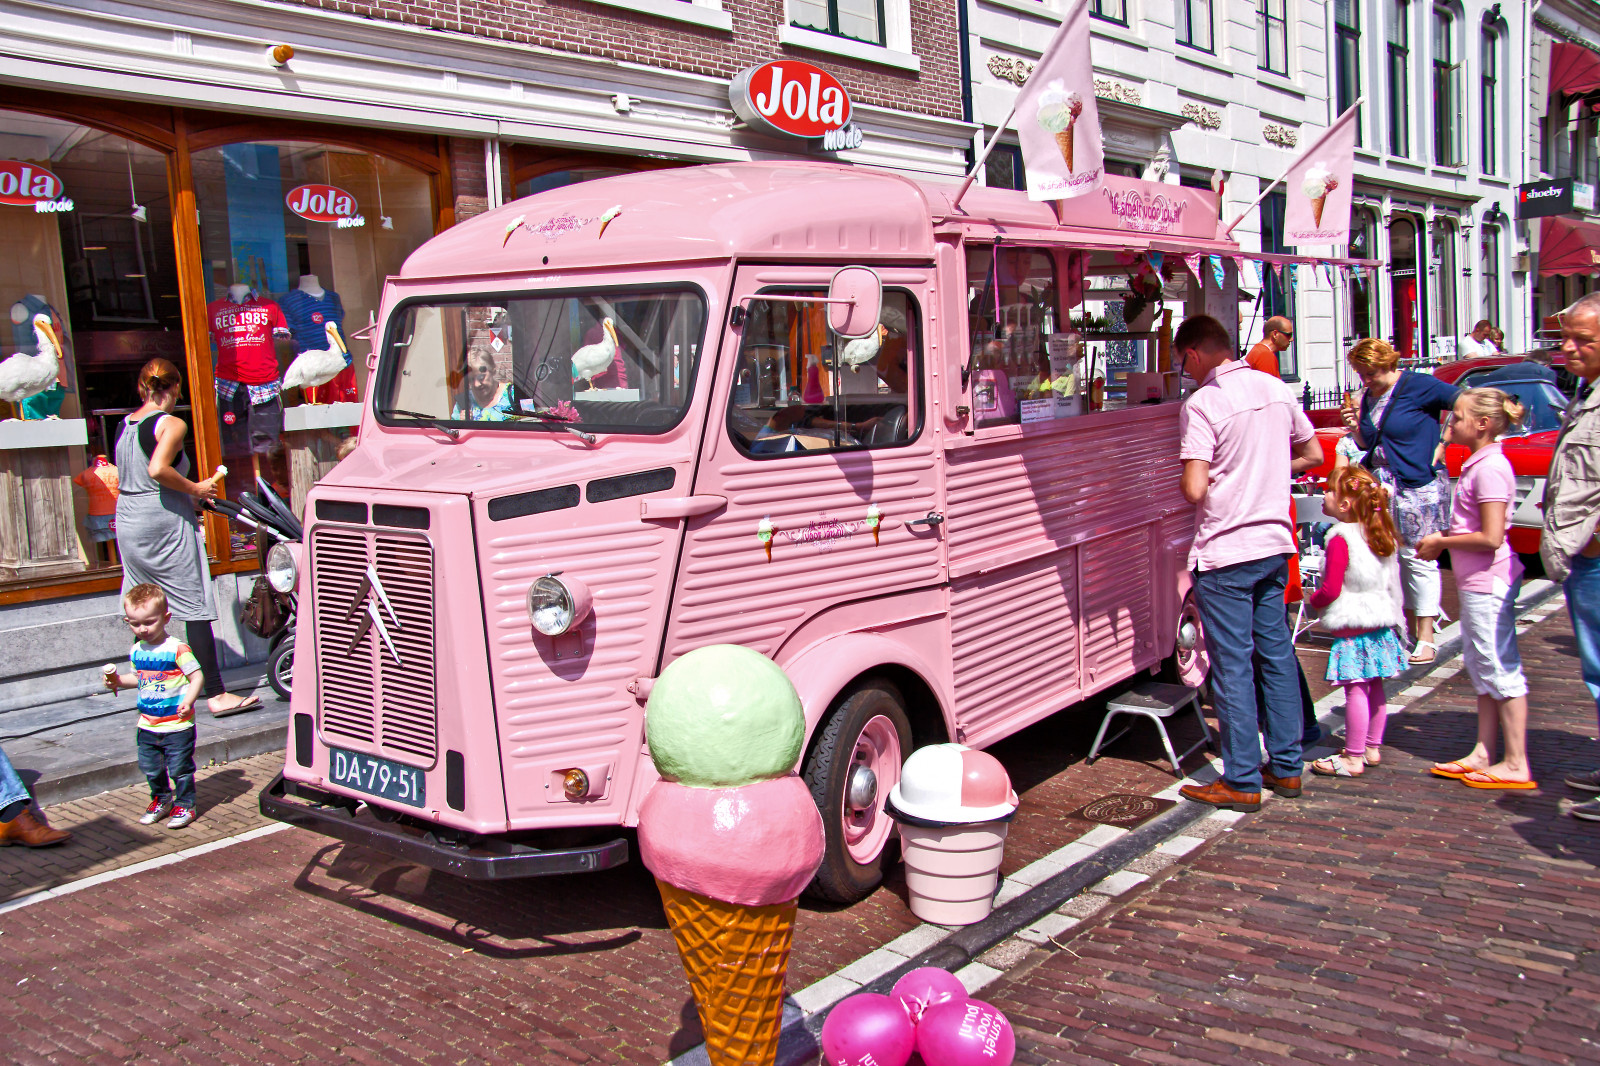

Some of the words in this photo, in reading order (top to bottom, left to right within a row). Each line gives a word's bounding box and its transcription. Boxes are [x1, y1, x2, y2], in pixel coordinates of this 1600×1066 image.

[756, 66, 844, 126] Jola
[823, 123, 863, 151] mode
[35, 196, 75, 213] mode
[292, 188, 352, 215] Jola
[1526, 185, 1564, 199] shoeby
[337, 213, 366, 229] mode
[215, 312, 268, 330] REG.1985
[154, 684, 166, 692] 75
[958, 1003, 984, 1039] jou.nl
[975, 1012, 993, 1042] voor
[982, 1020, 1002, 1058] smelt
